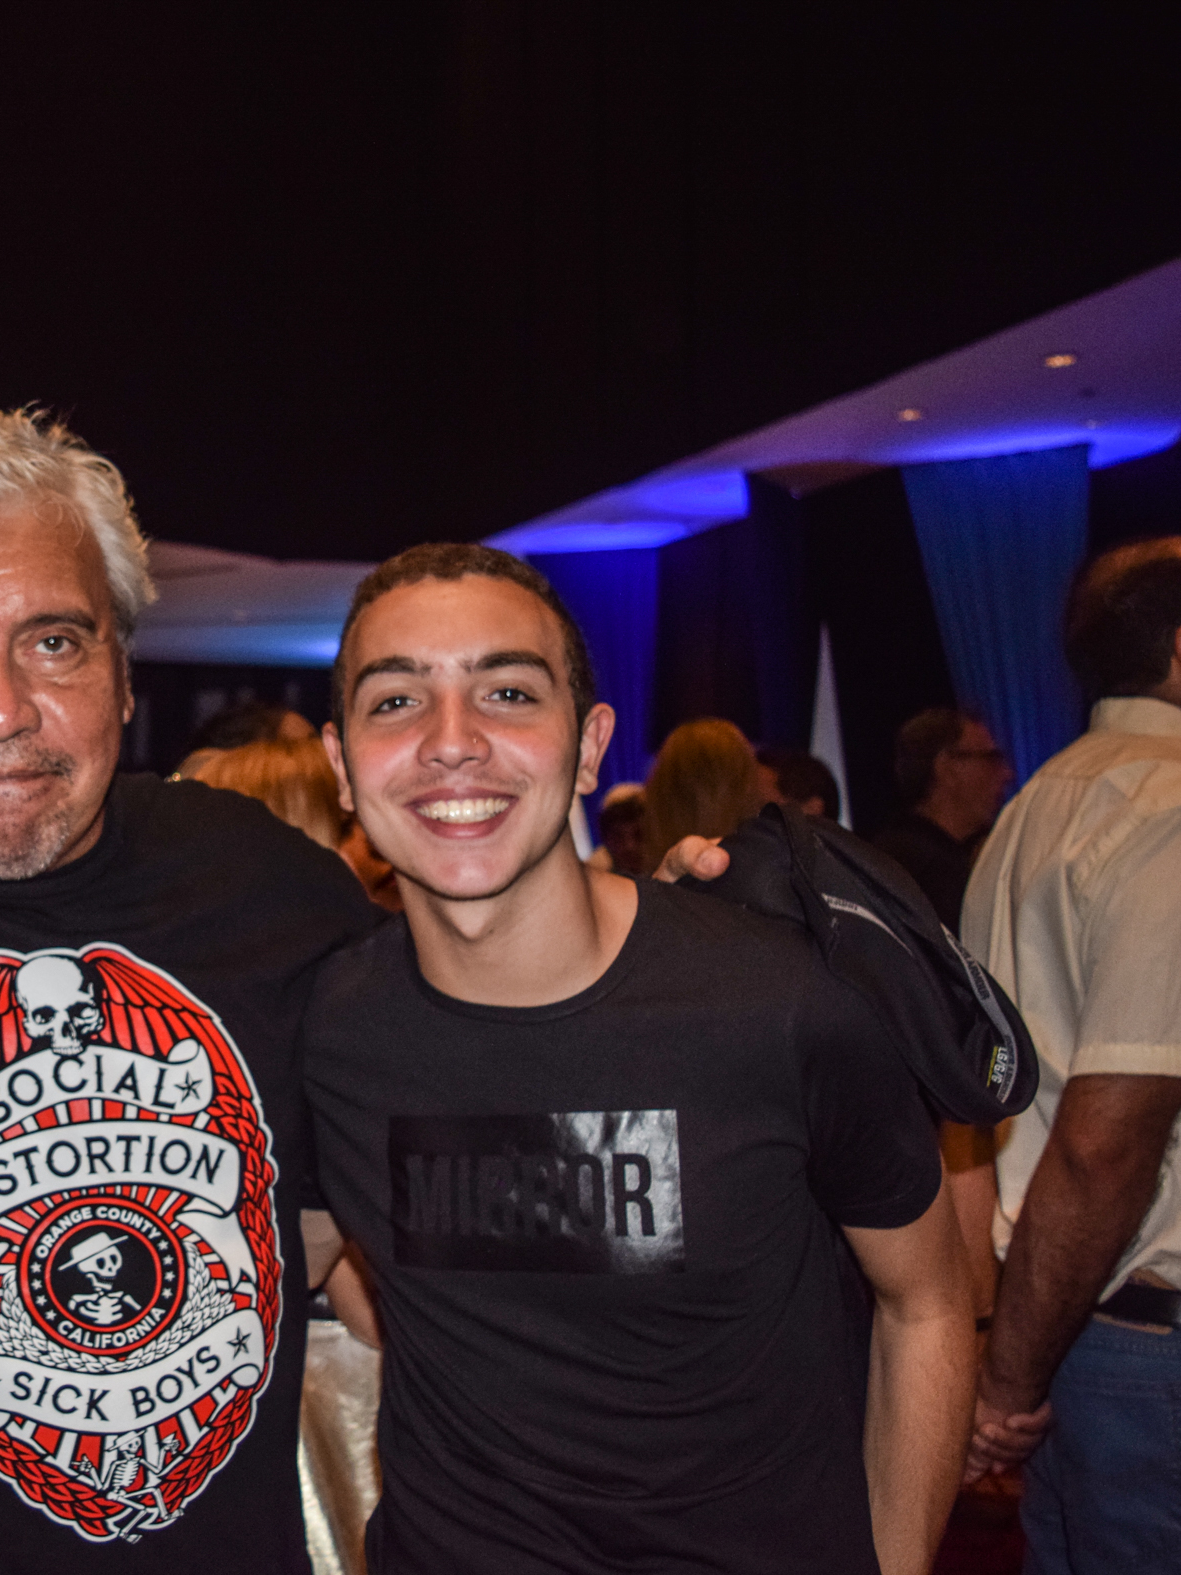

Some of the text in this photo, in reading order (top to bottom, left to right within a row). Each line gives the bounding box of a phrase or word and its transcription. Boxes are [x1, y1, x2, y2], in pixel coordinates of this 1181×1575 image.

[406, 1153, 654, 1237] MIRROR
[36, 1206, 162, 1259] ORANGE COUNTY
[57, 1308, 166, 1348] CALIFORNIA
[10, 1345, 221, 1422] SICK BOYS
